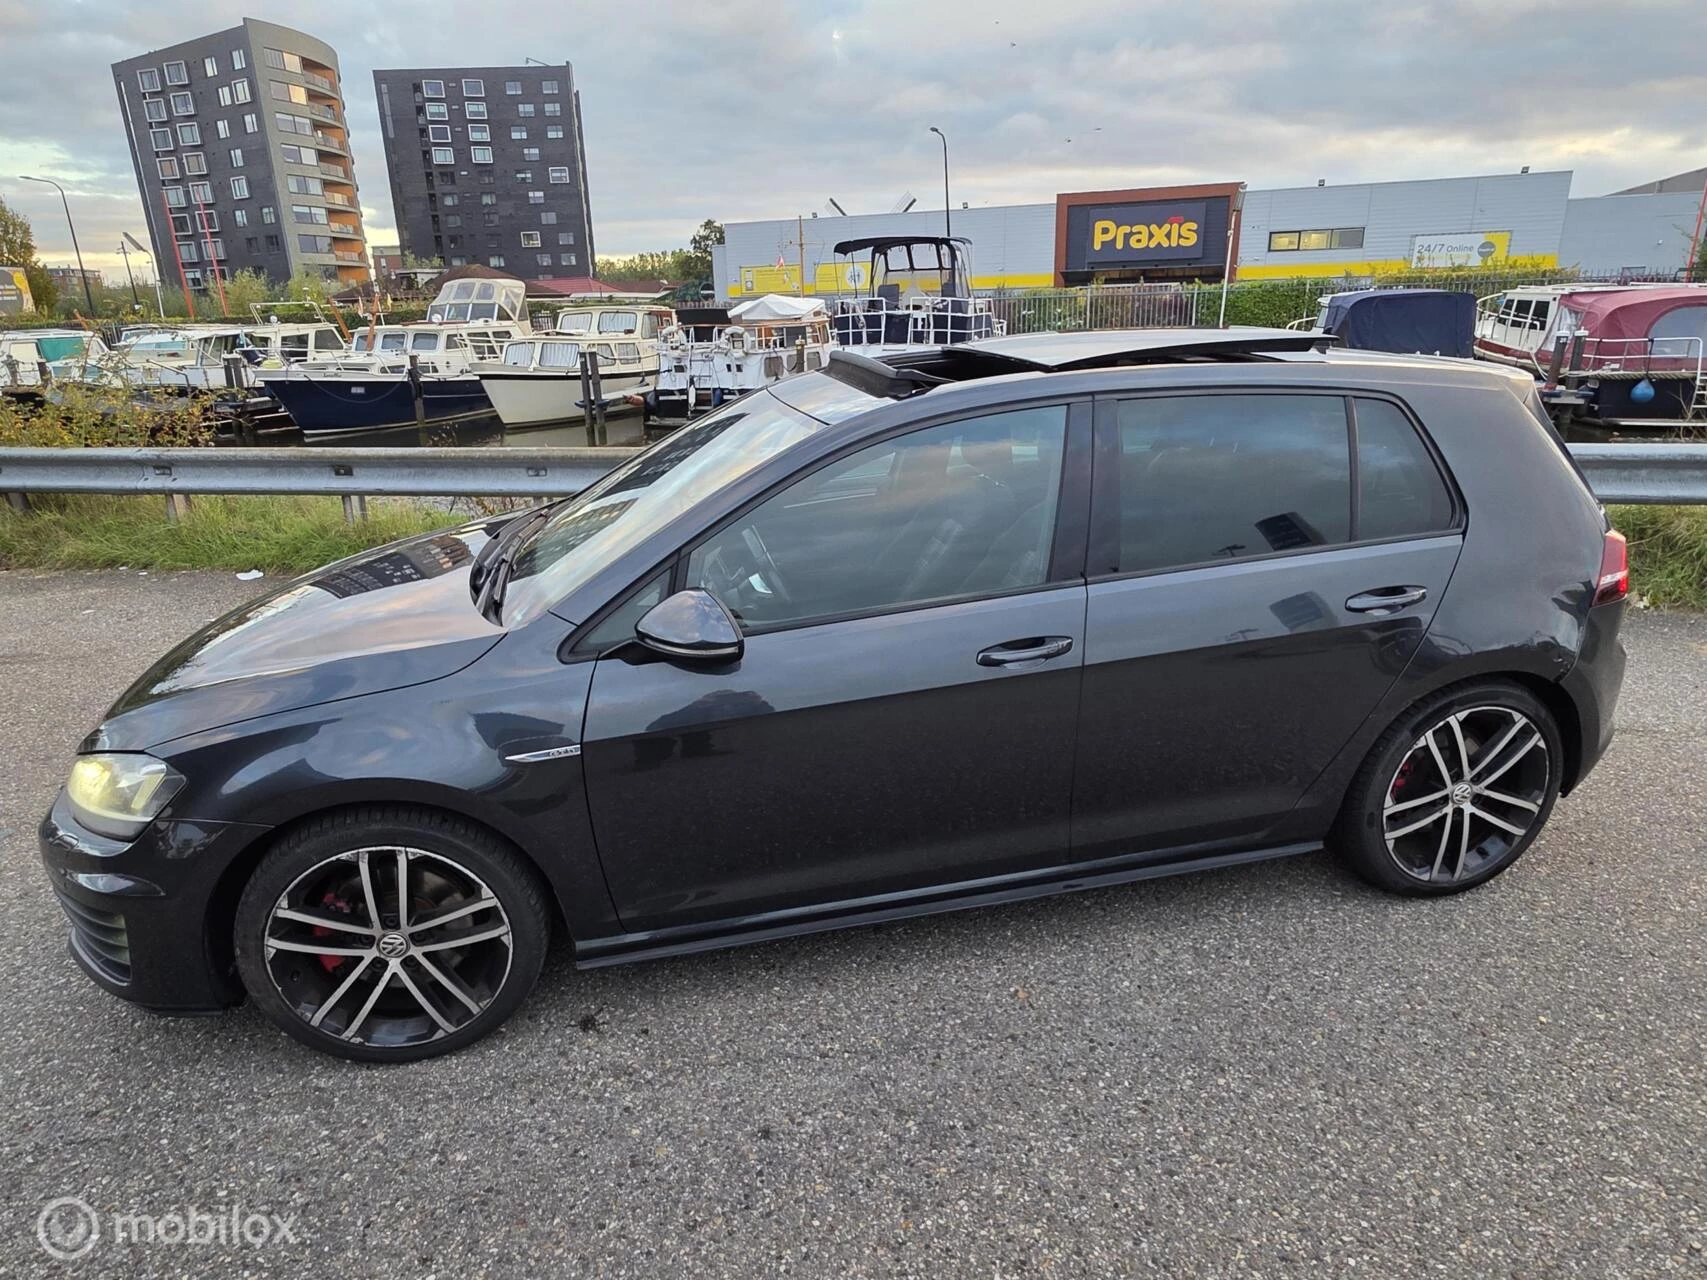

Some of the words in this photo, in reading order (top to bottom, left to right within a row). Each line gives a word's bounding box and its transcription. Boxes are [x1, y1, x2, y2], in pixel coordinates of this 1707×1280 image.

[1093, 216, 1198, 251] Praxis
[1417, 243, 1445, 254] 24/7
[1446, 243, 1474, 253] Online
